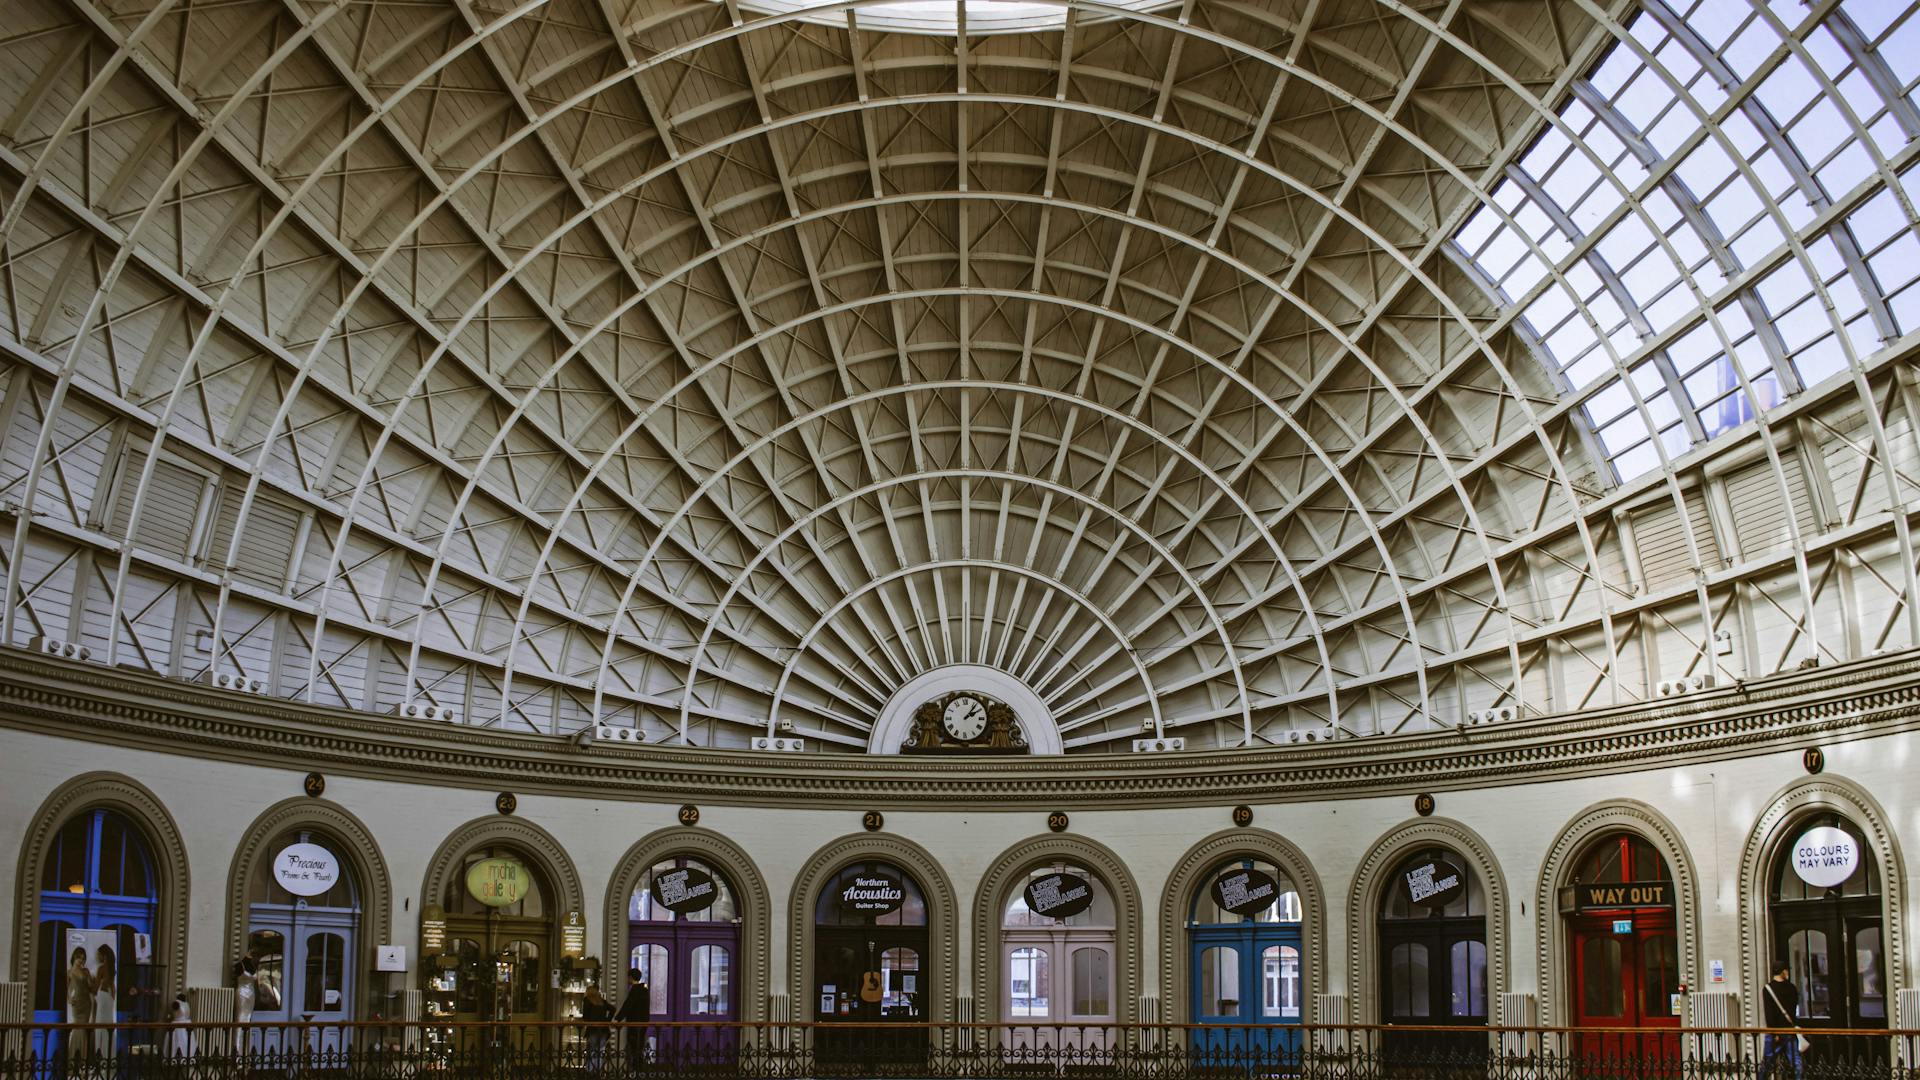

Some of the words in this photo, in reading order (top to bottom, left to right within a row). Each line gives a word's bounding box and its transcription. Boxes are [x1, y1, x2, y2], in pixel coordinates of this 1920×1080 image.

[1807, 752, 1819, 766] 17
[309, 778, 322, 790] 24
[1418, 798, 1431, 810] 18
[682, 809, 698, 821] 22
[866, 815, 880, 826] 21
[1050, 815, 1067, 827] 20
[1236, 810, 1249, 821] 19
[1799, 845, 1850, 857] COLOURS
[287, 854, 327, 869] Precious
[1800, 859, 1820, 869] MAY
[1823, 857, 1849, 867] VARY
[301, 872, 310, 880] &
[855, 878, 889, 887] Northern
[1412, 875, 1459, 902] EXCHANGE
[482, 880, 516, 902] galley
[663, 882, 712, 906] EXCHANGE
[843, 886, 902, 902] Acoustics
[1225, 884, 1273, 910] EXCHANGE
[1590, 888, 1625, 904] WAY
[1631, 887, 1663, 903] OUT
[1036, 886, 1088, 912] EXCHANGE
[874, 902, 890, 910] Shop
